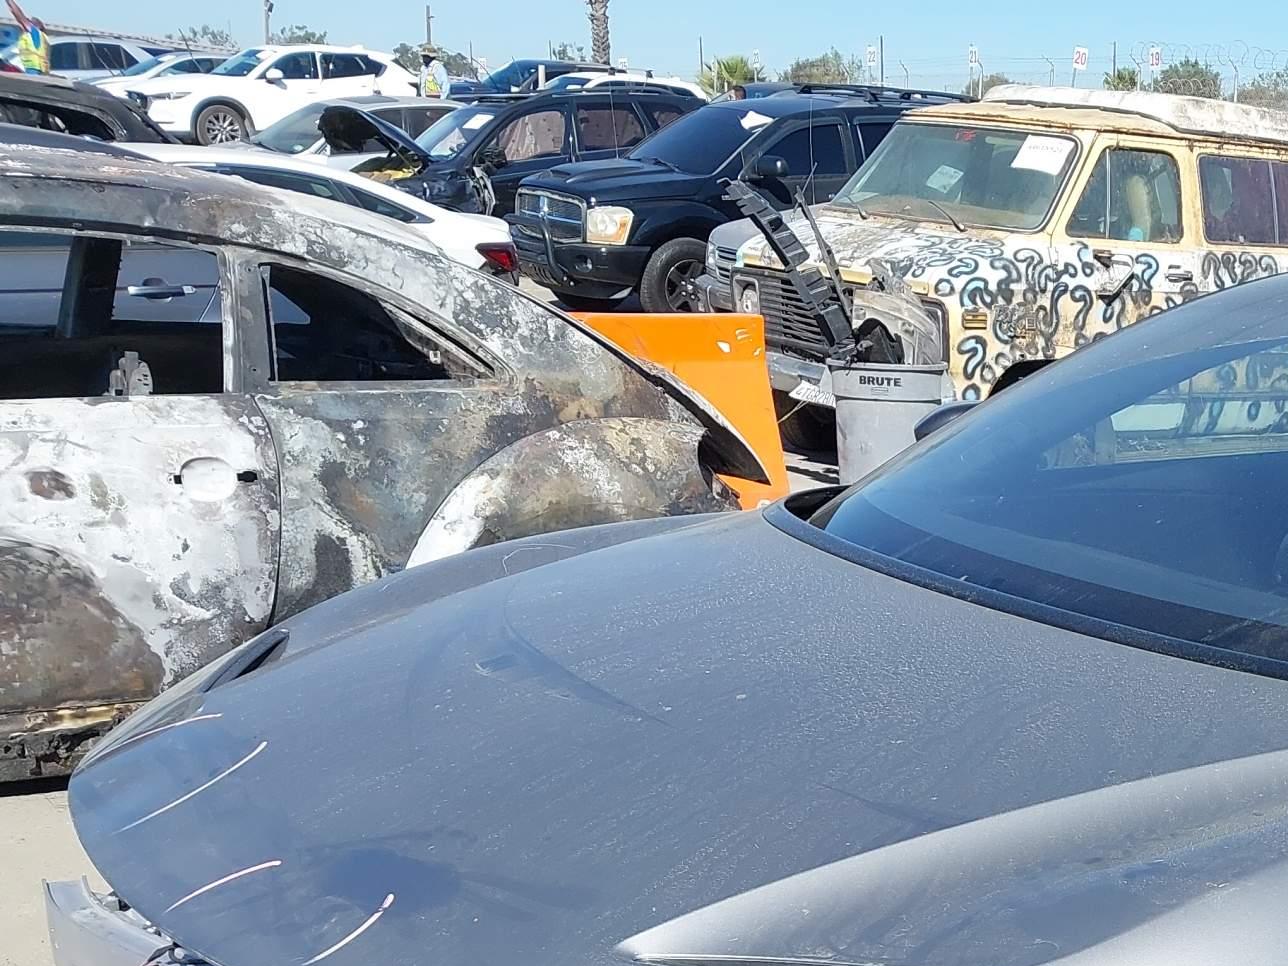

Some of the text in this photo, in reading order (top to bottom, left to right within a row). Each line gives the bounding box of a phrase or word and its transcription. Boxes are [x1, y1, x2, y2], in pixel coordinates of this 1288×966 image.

[969, 50, 977, 64] 21
[1074, 51, 1087, 66] 20
[1150, 51, 1160, 66] 19
[858, 375, 903, 388] BRUTE
